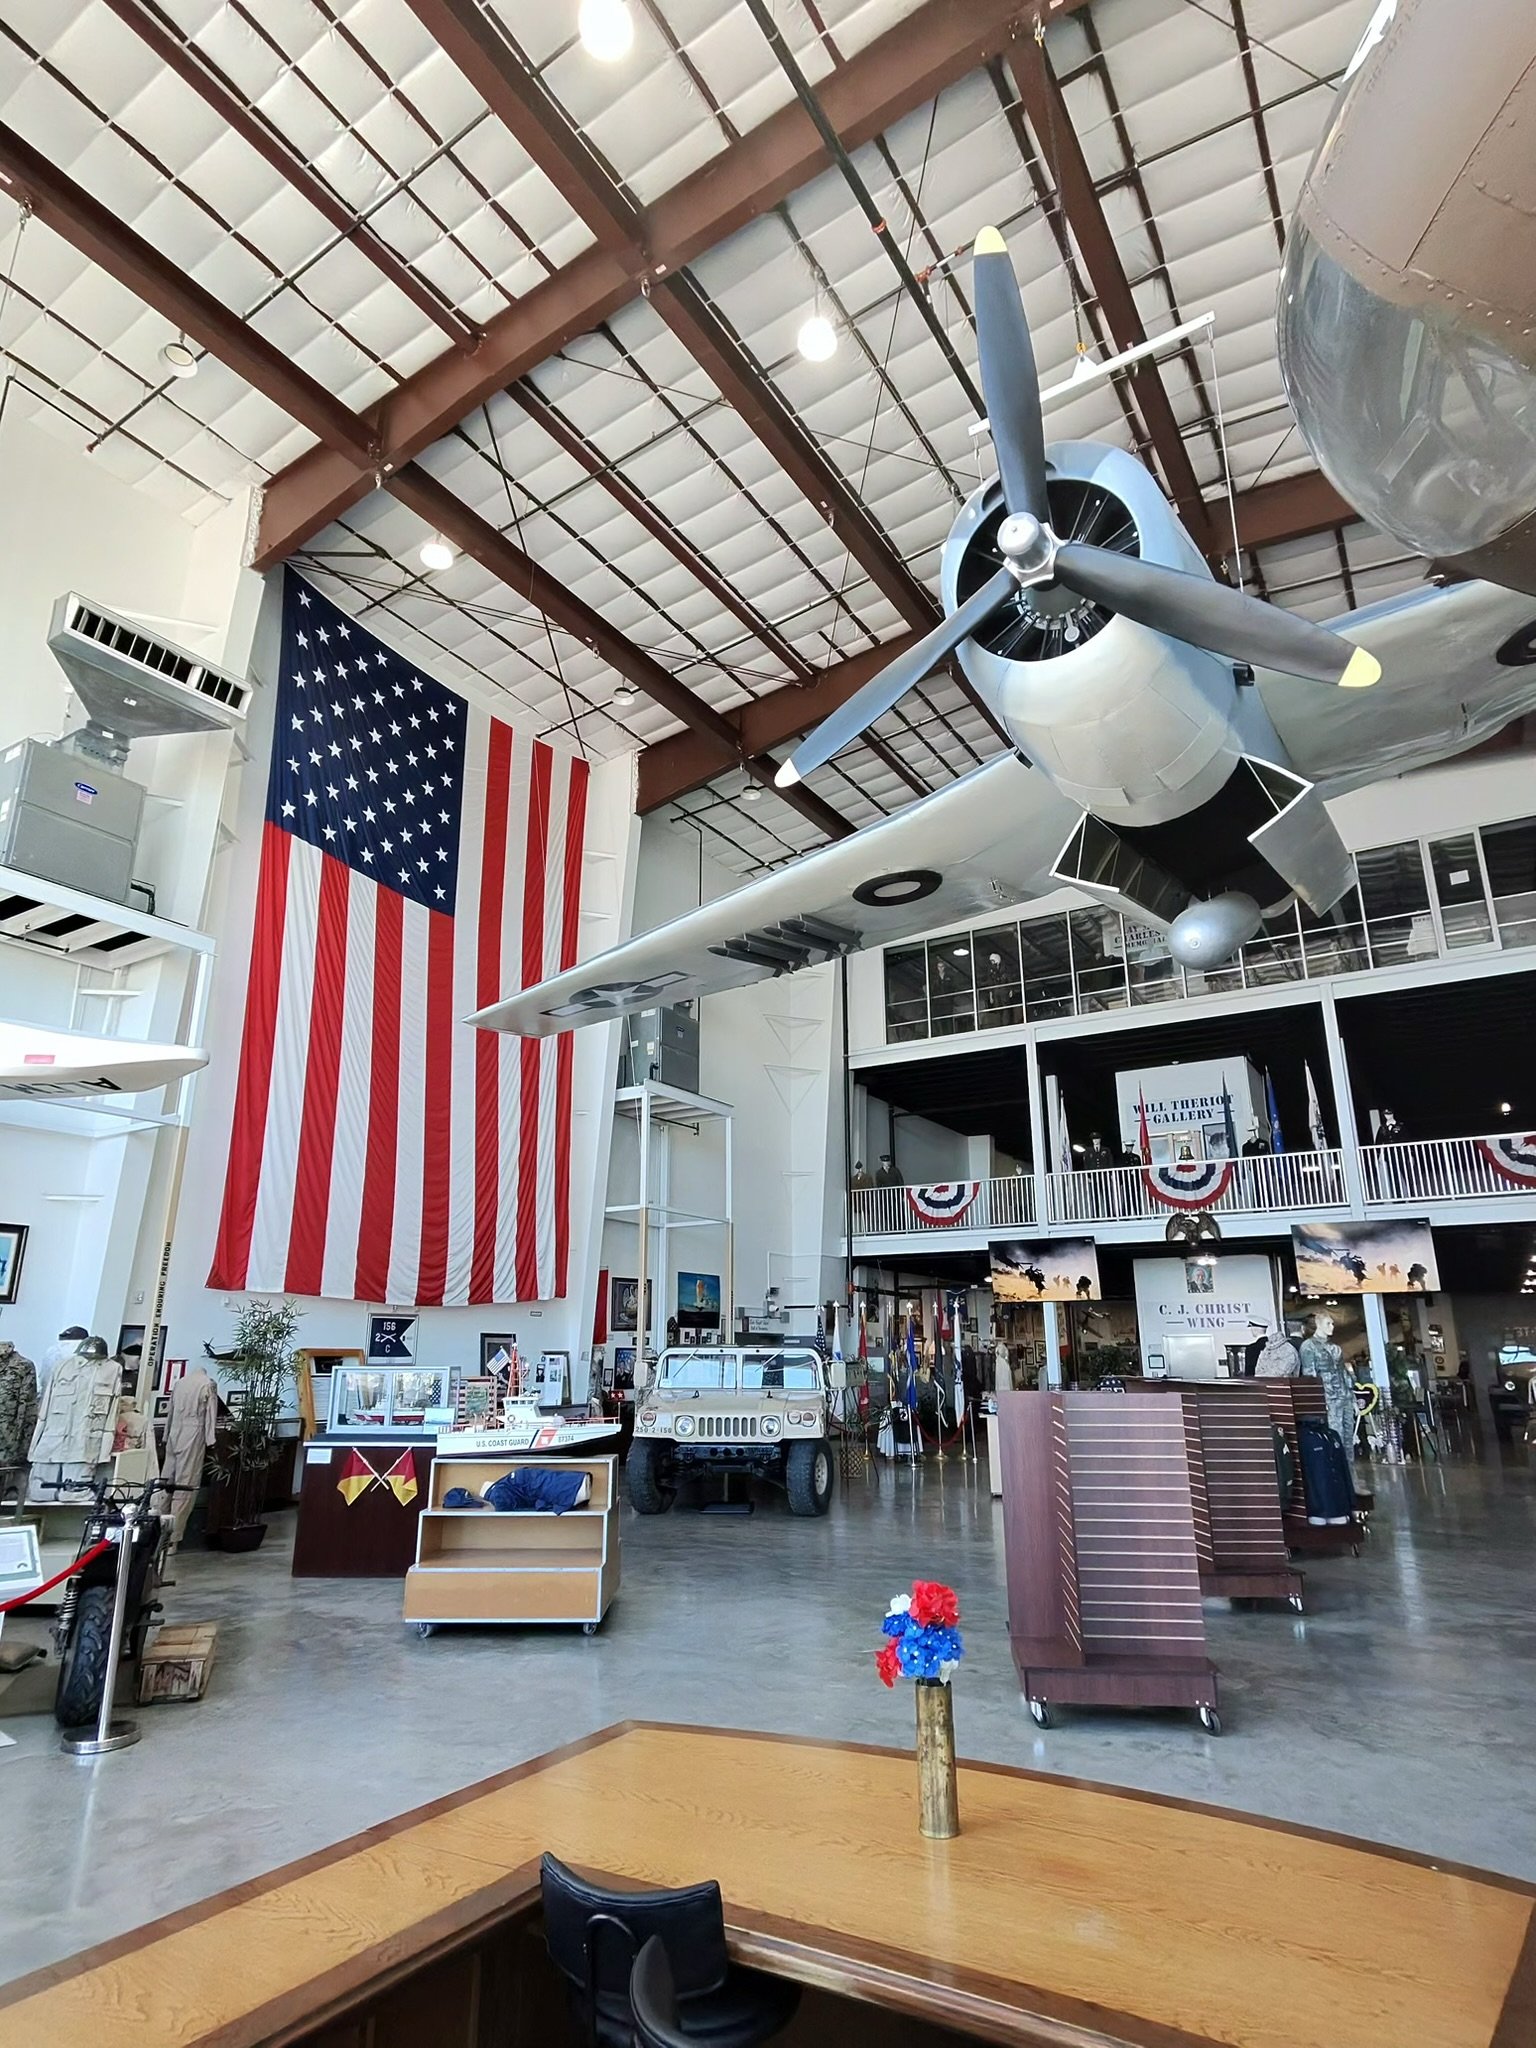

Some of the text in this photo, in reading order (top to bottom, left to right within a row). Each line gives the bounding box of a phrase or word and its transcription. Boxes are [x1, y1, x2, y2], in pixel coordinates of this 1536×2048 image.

[1133, 1094, 1234, 1115] WILL THERIOT
[1153, 1109, 1214, 1124] GALLERY
[147, 1241, 171, 1367] OPERATION ENDURING FREEDOM
[1159, 1303, 1251, 1315] C. J. CHRIST
[383, 1321, 396, 1331] 156
[1187, 1317, 1225, 1328] WING
[375, 1332, 381, 1342] 2
[385, 1344, 391, 1353] C
[476, 1438, 530, 1448] U.S. COAST GUARD
